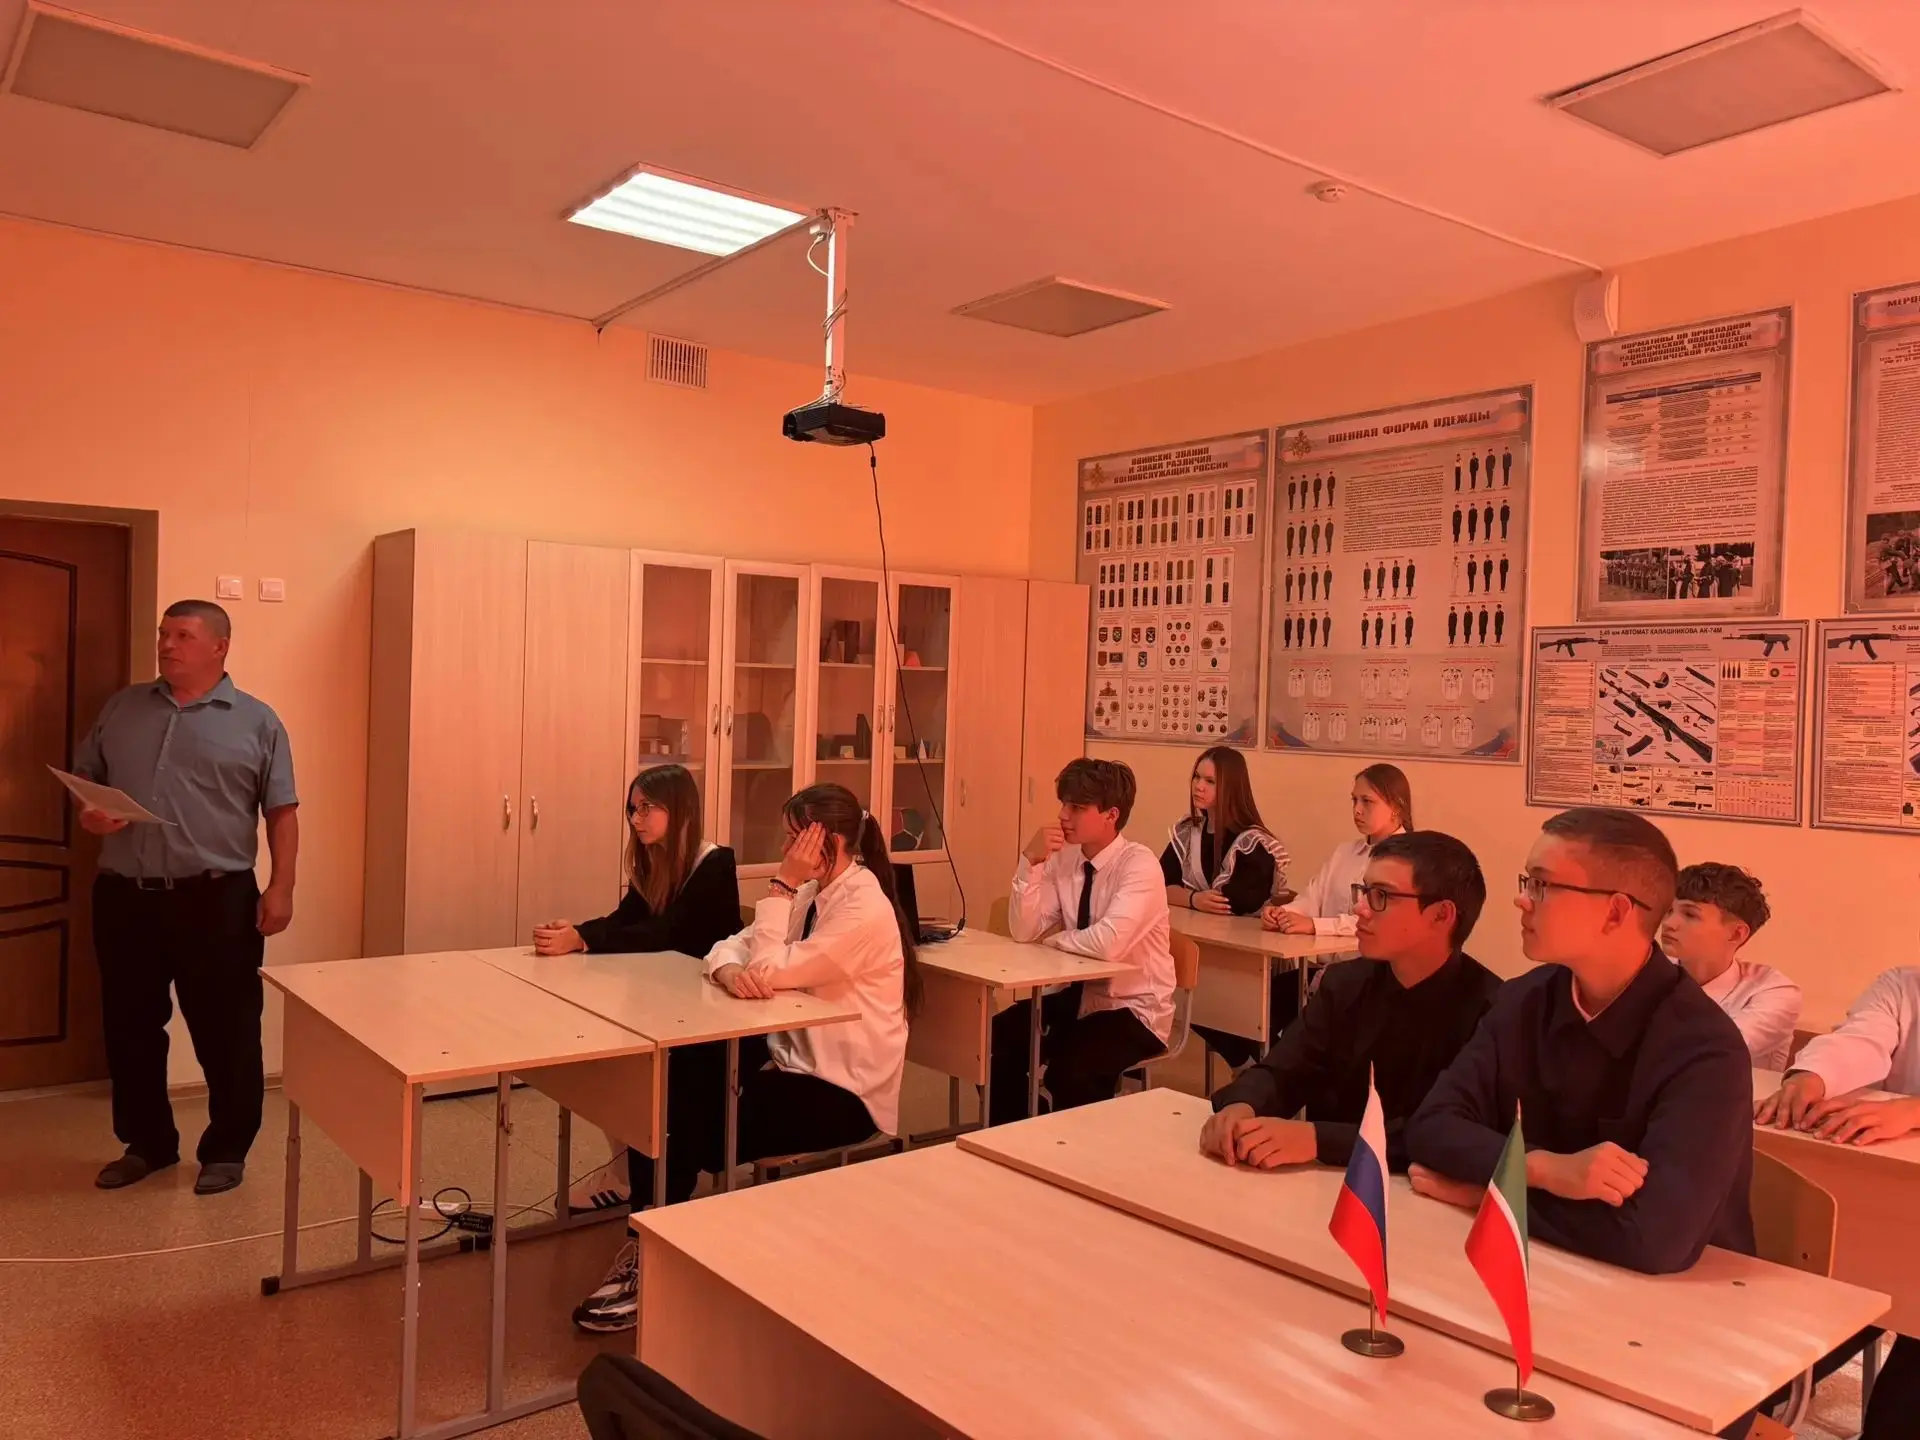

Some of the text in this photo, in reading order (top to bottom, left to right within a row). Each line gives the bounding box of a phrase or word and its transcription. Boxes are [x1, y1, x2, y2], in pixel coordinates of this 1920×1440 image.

[1621, 335, 1674, 350] НОРМАТИВЫ
[1691, 321, 1751, 338] ПРИКЛАДНОЙ
[1692, 334, 1752, 349] ХИМИЧЕСКОЙ
[1627, 339, 1685, 354] ФИЗИЧЕСКОЙ
[1631, 350, 1701, 366] БИОЛОГИЧЕСКОЙ
[1328, 410, 1490, 444] ВОЕННАЯ ФОРМА ОДЕЖДЫ
[1131, 447, 1209, 465] ВОИНСКИЕ ЗВАНИЯ
[1137, 462, 1164, 473] ЗНАКИ
[1166, 455, 1212, 469] РАЗЛИЧИЯ
[1113, 461, 1229, 484] ВОЕННОСЛУЖАЩИХ РОССИИ
[1650, 627, 1698, 635] КАЛАШНИКОВА
[1699, 626, 1723, 634] АК-74М
